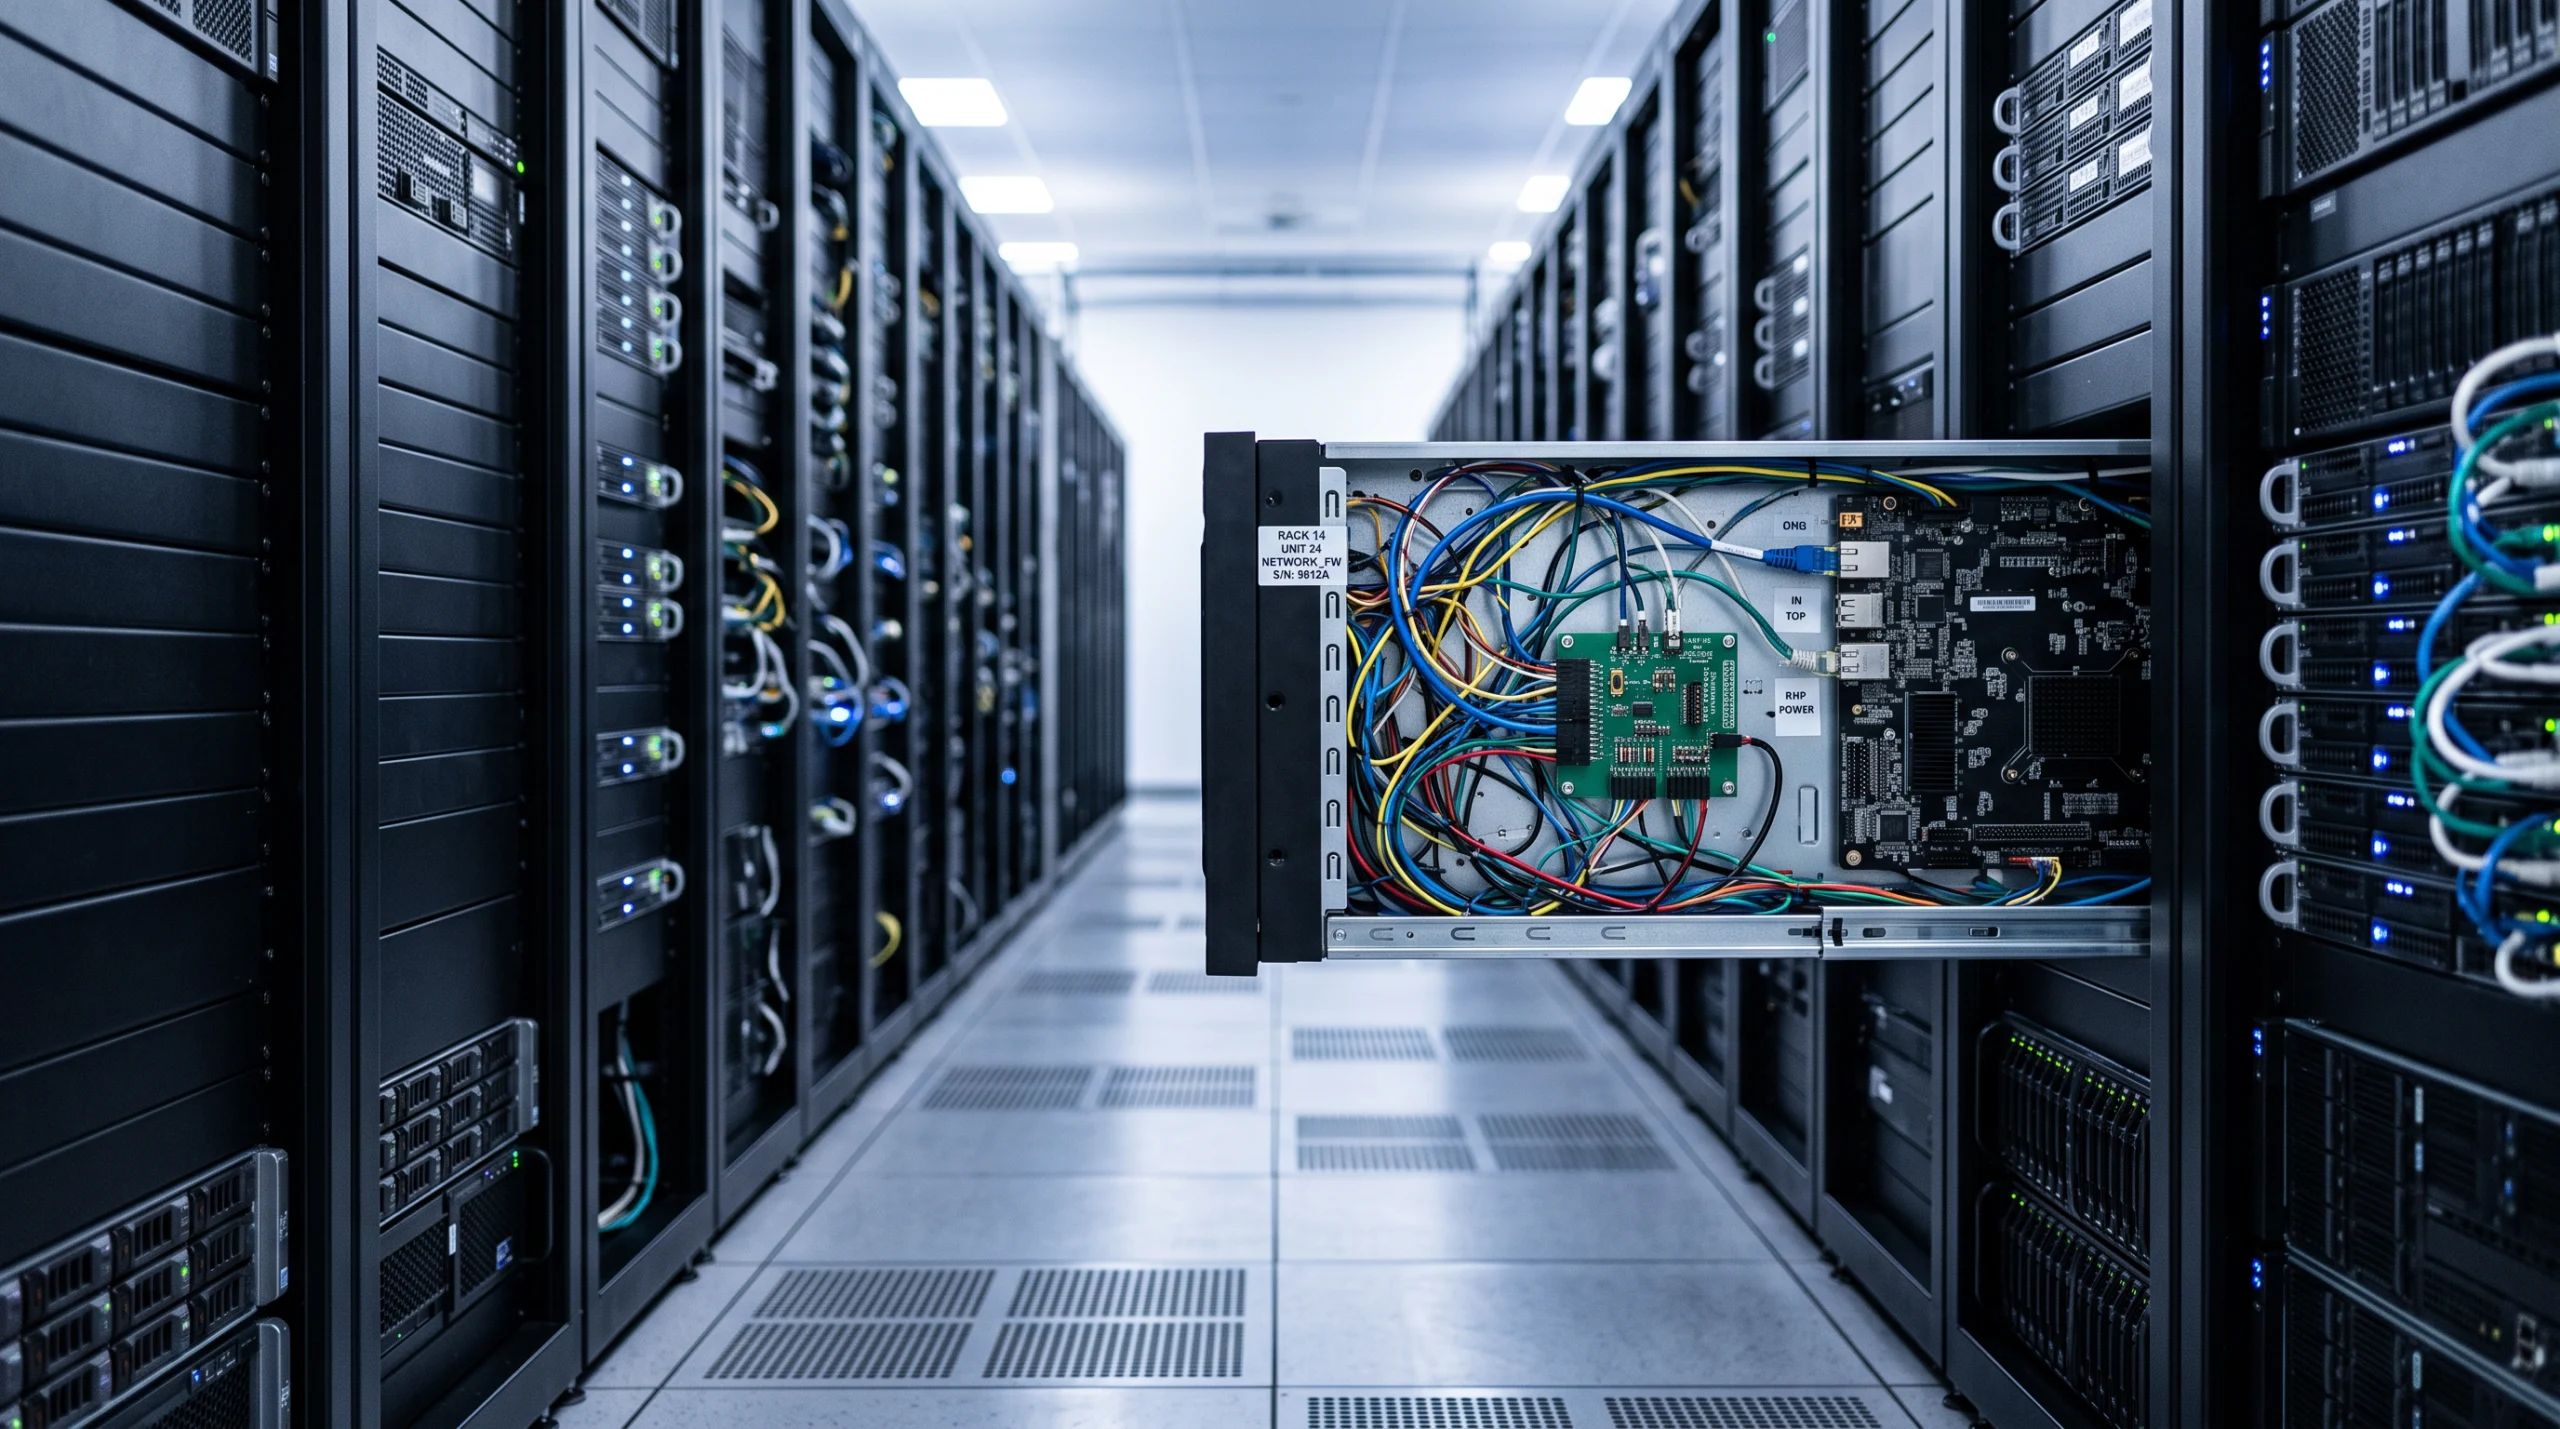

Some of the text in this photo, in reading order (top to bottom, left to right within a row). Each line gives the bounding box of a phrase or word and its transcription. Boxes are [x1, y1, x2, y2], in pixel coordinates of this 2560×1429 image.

[1278, 530, 1326, 541] RACK 14
[1281, 544, 1322, 554] UNIT 24
[1261, 557, 1342, 569] NETWORK_FW
[1272, 569, 1295, 580] S/N:
[1791, 596, 1802, 605] IN
[1785, 611, 1806, 621] TOP
[1785, 691, 1807, 701] RHP
[1779, 705, 1815, 715] POWER
